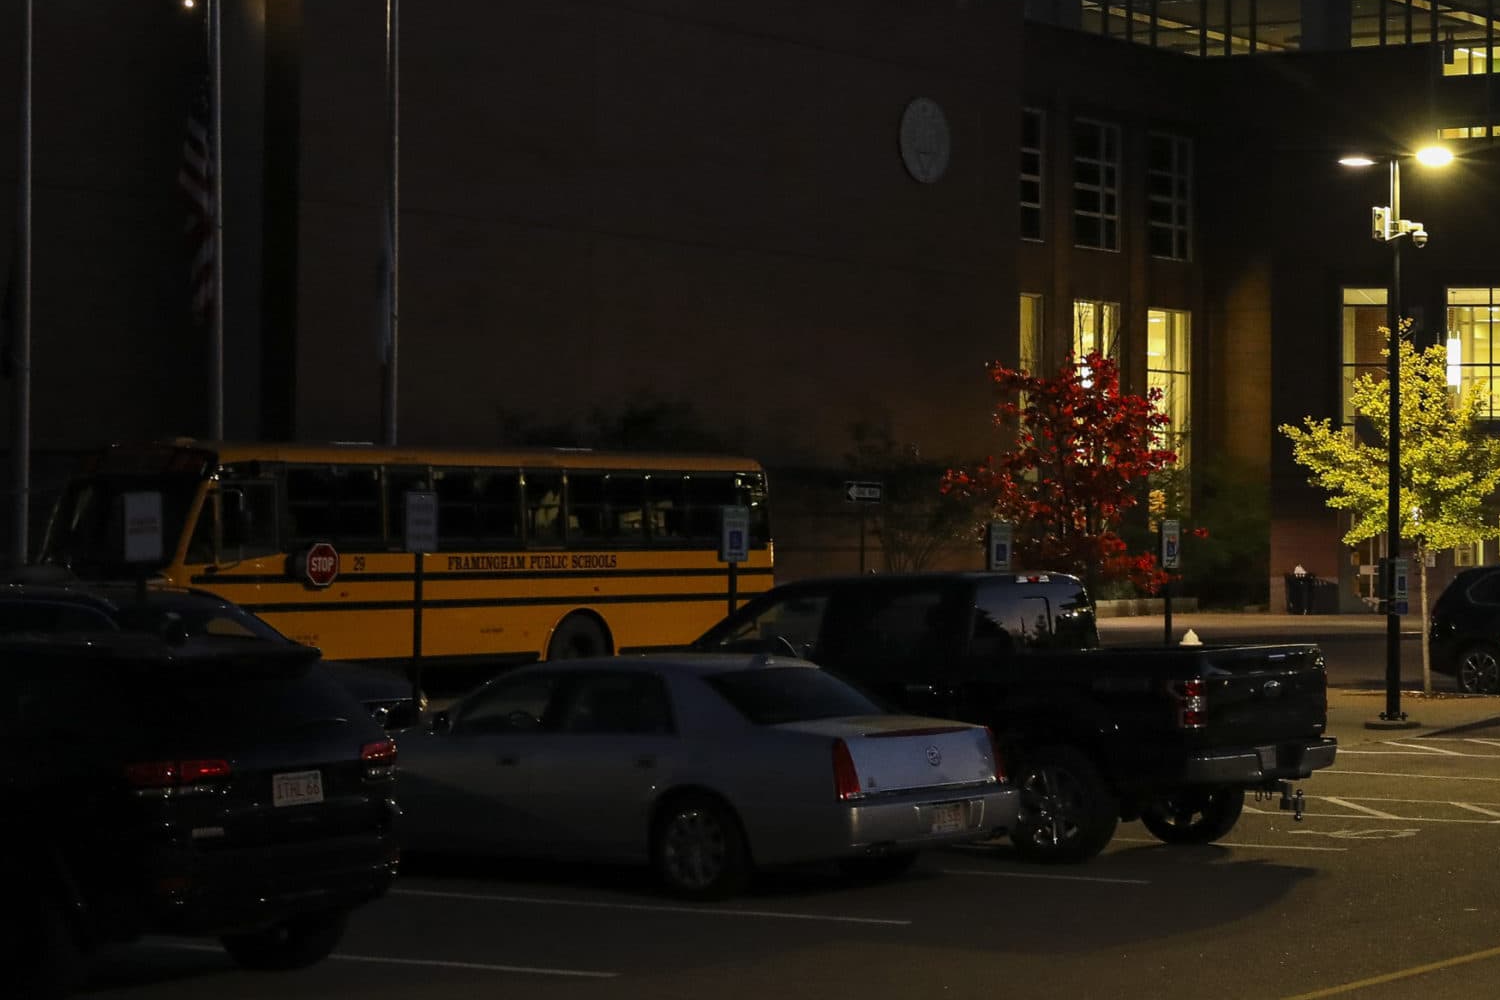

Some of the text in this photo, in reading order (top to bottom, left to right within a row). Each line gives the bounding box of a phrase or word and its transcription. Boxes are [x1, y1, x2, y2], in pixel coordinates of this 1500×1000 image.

[311, 557, 334, 572] STOP
[448, 553, 617, 570] FRAMINGHAM PUBLIC SCHOOLS
